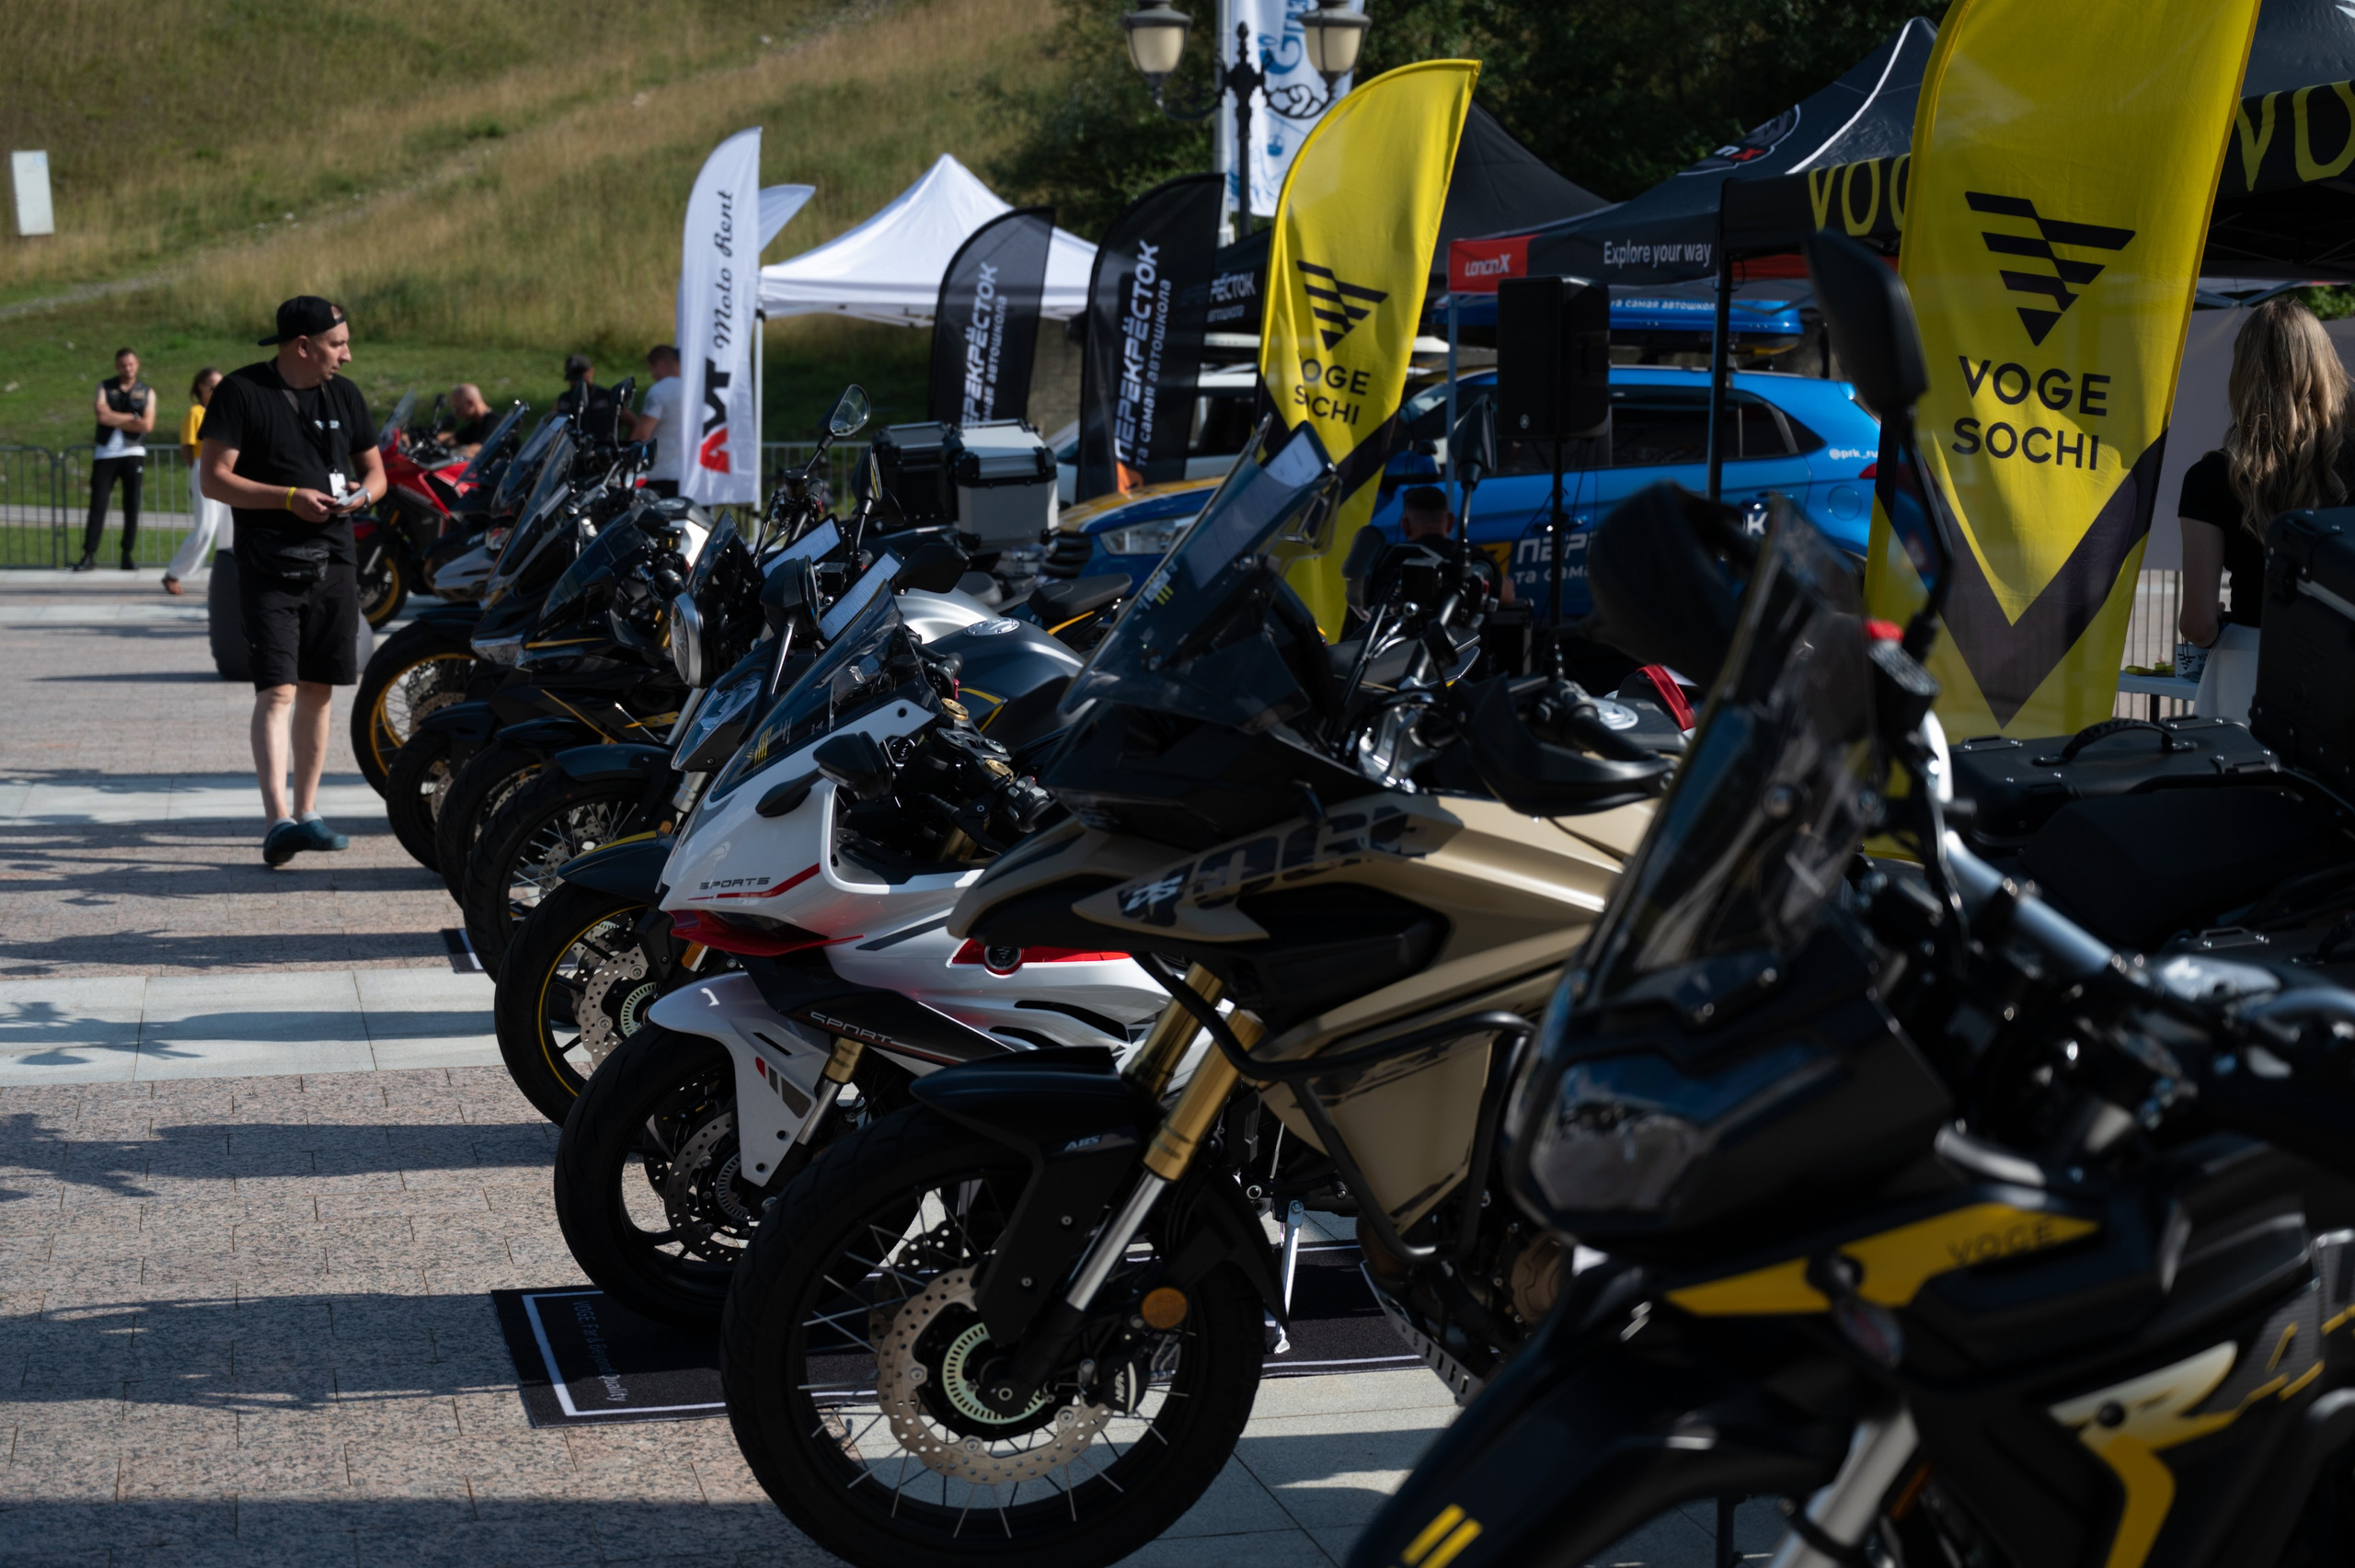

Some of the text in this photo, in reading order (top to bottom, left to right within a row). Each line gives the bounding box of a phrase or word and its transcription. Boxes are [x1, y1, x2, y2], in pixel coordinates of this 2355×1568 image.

[714, 189, 733, 258] Rent
[1604, 239, 1711, 269] Explore your way
[714, 268, 732, 349] Moto
[1147, 279, 1171, 382] автошкола
[985, 295, 1007, 383] автошкола
[1298, 350, 1371, 396] OGE
[1959, 355, 2111, 417] VOGE
[1140, 386, 1155, 442] самая
[1294, 384, 1360, 426] SCHI
[1951, 417, 2099, 470] SOCHI
[699, 876, 771, 890] SPORTS
[810, 1011, 892, 1043] SPORT
[1064, 1135, 1101, 1151] ABS
[1947, 1219, 2055, 1267] VOGE
[598, 1374, 627, 1402] Quality
